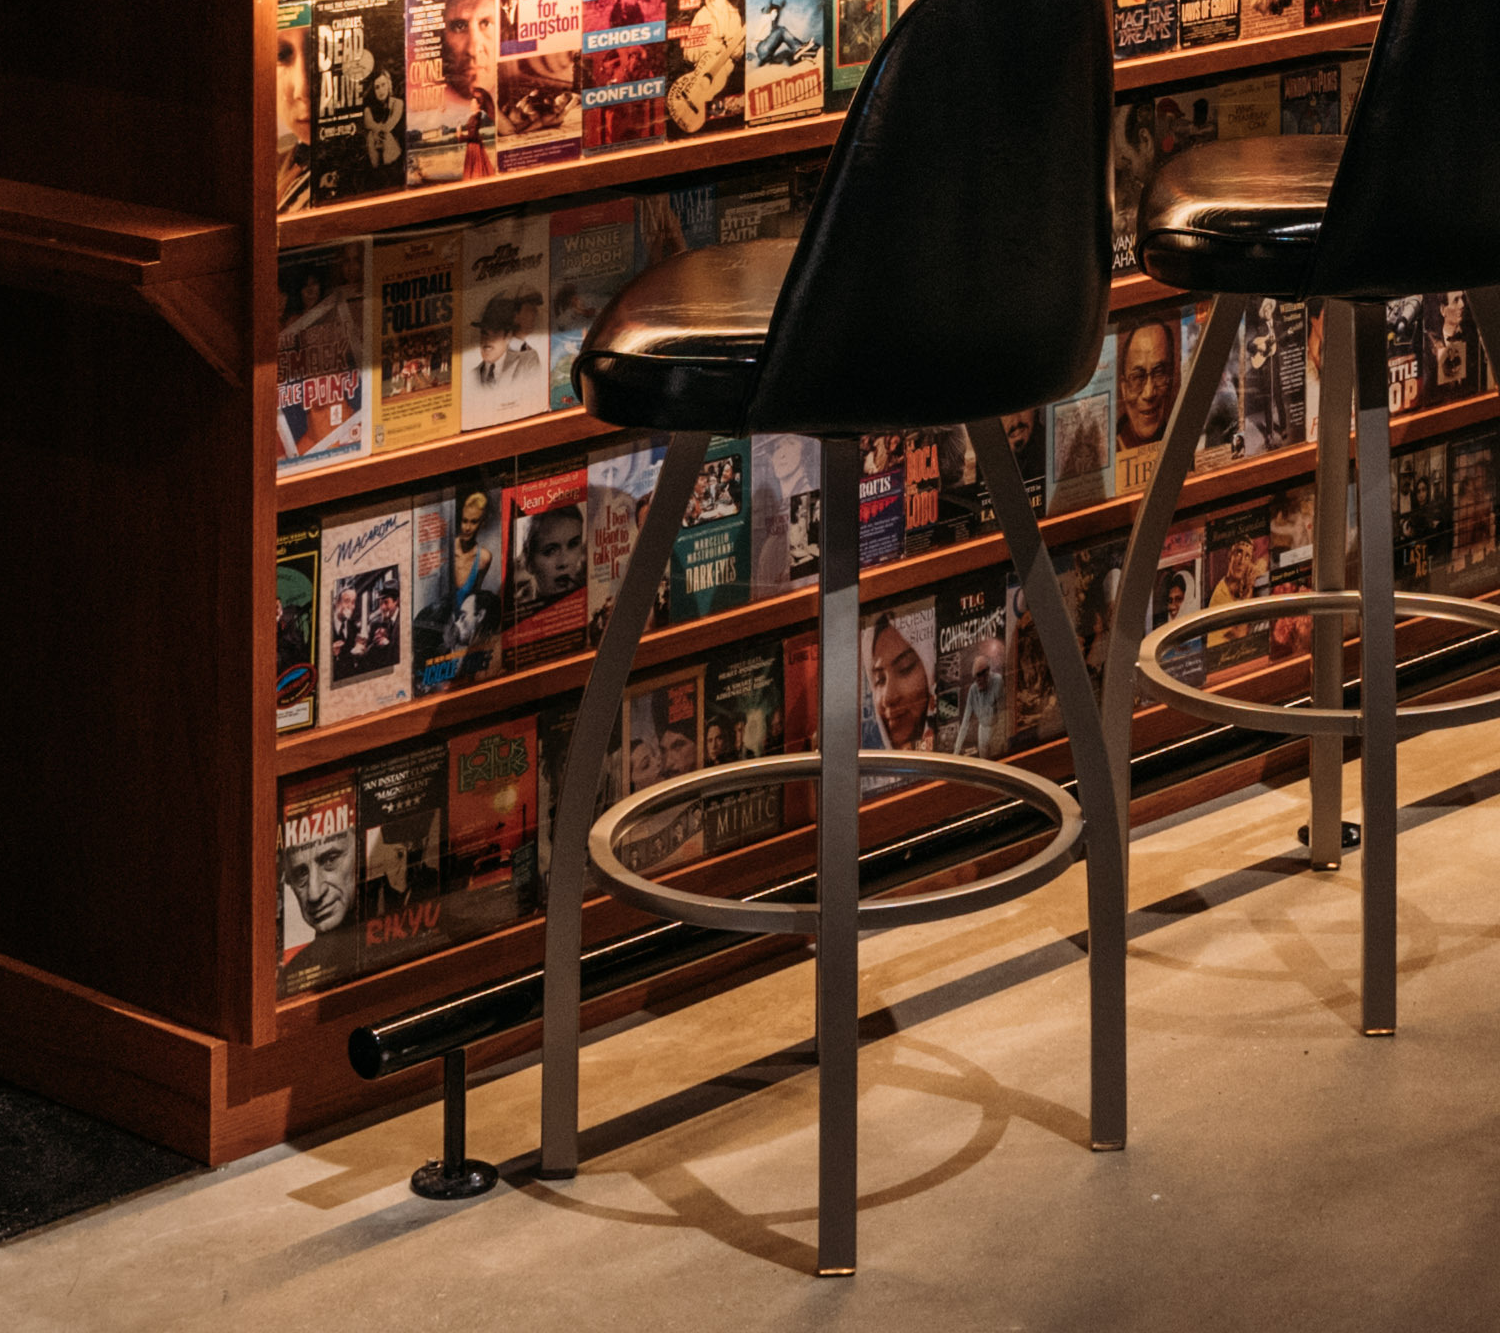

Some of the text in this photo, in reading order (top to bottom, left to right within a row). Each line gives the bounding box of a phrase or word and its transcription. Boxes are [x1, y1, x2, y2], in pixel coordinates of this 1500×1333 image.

[537, 0, 558, 19] for
[1114, 4, 1175, 30] MACHINE
[1181, 0, 1201, 23] LAWS
[587, 27, 651, 50] ECHOES
[1118, 21, 1172, 47] DREAMS
[318, 24, 365, 72] DEAD
[319, 71, 364, 118] ALIVE
[585, 80, 664, 106] CONFLICT
[753, 74, 820, 115] in bloom
[720, 215, 762, 231] LITTLE
[720, 227, 759, 245] FAITH
[563, 230, 621, 253] WINNIE
[581, 249, 622, 268] POOH
[381, 270, 453, 306] FOOTBALL
[381, 293, 453, 336] FOLLIES
[277, 341, 350, 384] SMACK
[276, 383, 303, 409] THE
[303, 370, 360, 411] PONY
[905, 443, 941, 485] BOCA
[520, 485, 582, 512] Jean Seberg
[859, 475, 892, 499] RQUIS
[905, 489, 940, 531] LOBO
[959, 591, 986, 608] TLC
[715, 794, 777, 838] MIMIC
[365, 900, 442, 948] RIKYU
